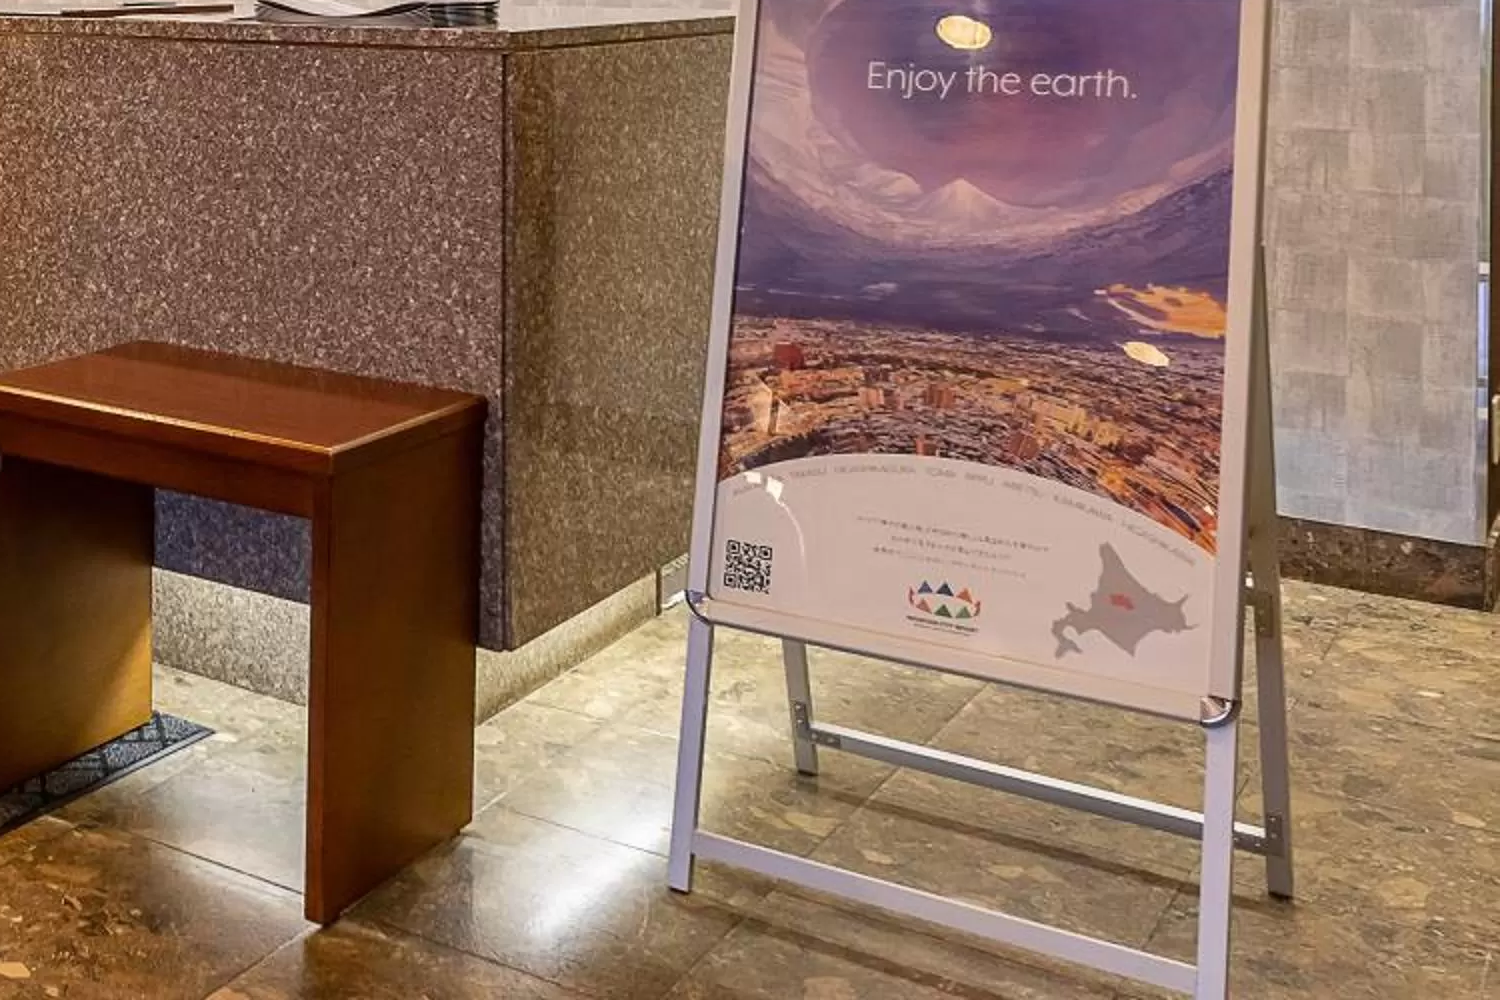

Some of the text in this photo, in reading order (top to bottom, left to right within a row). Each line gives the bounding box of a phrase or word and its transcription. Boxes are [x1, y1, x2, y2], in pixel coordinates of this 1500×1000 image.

[867, 61, 1137, 99] Enjoy the earth.
